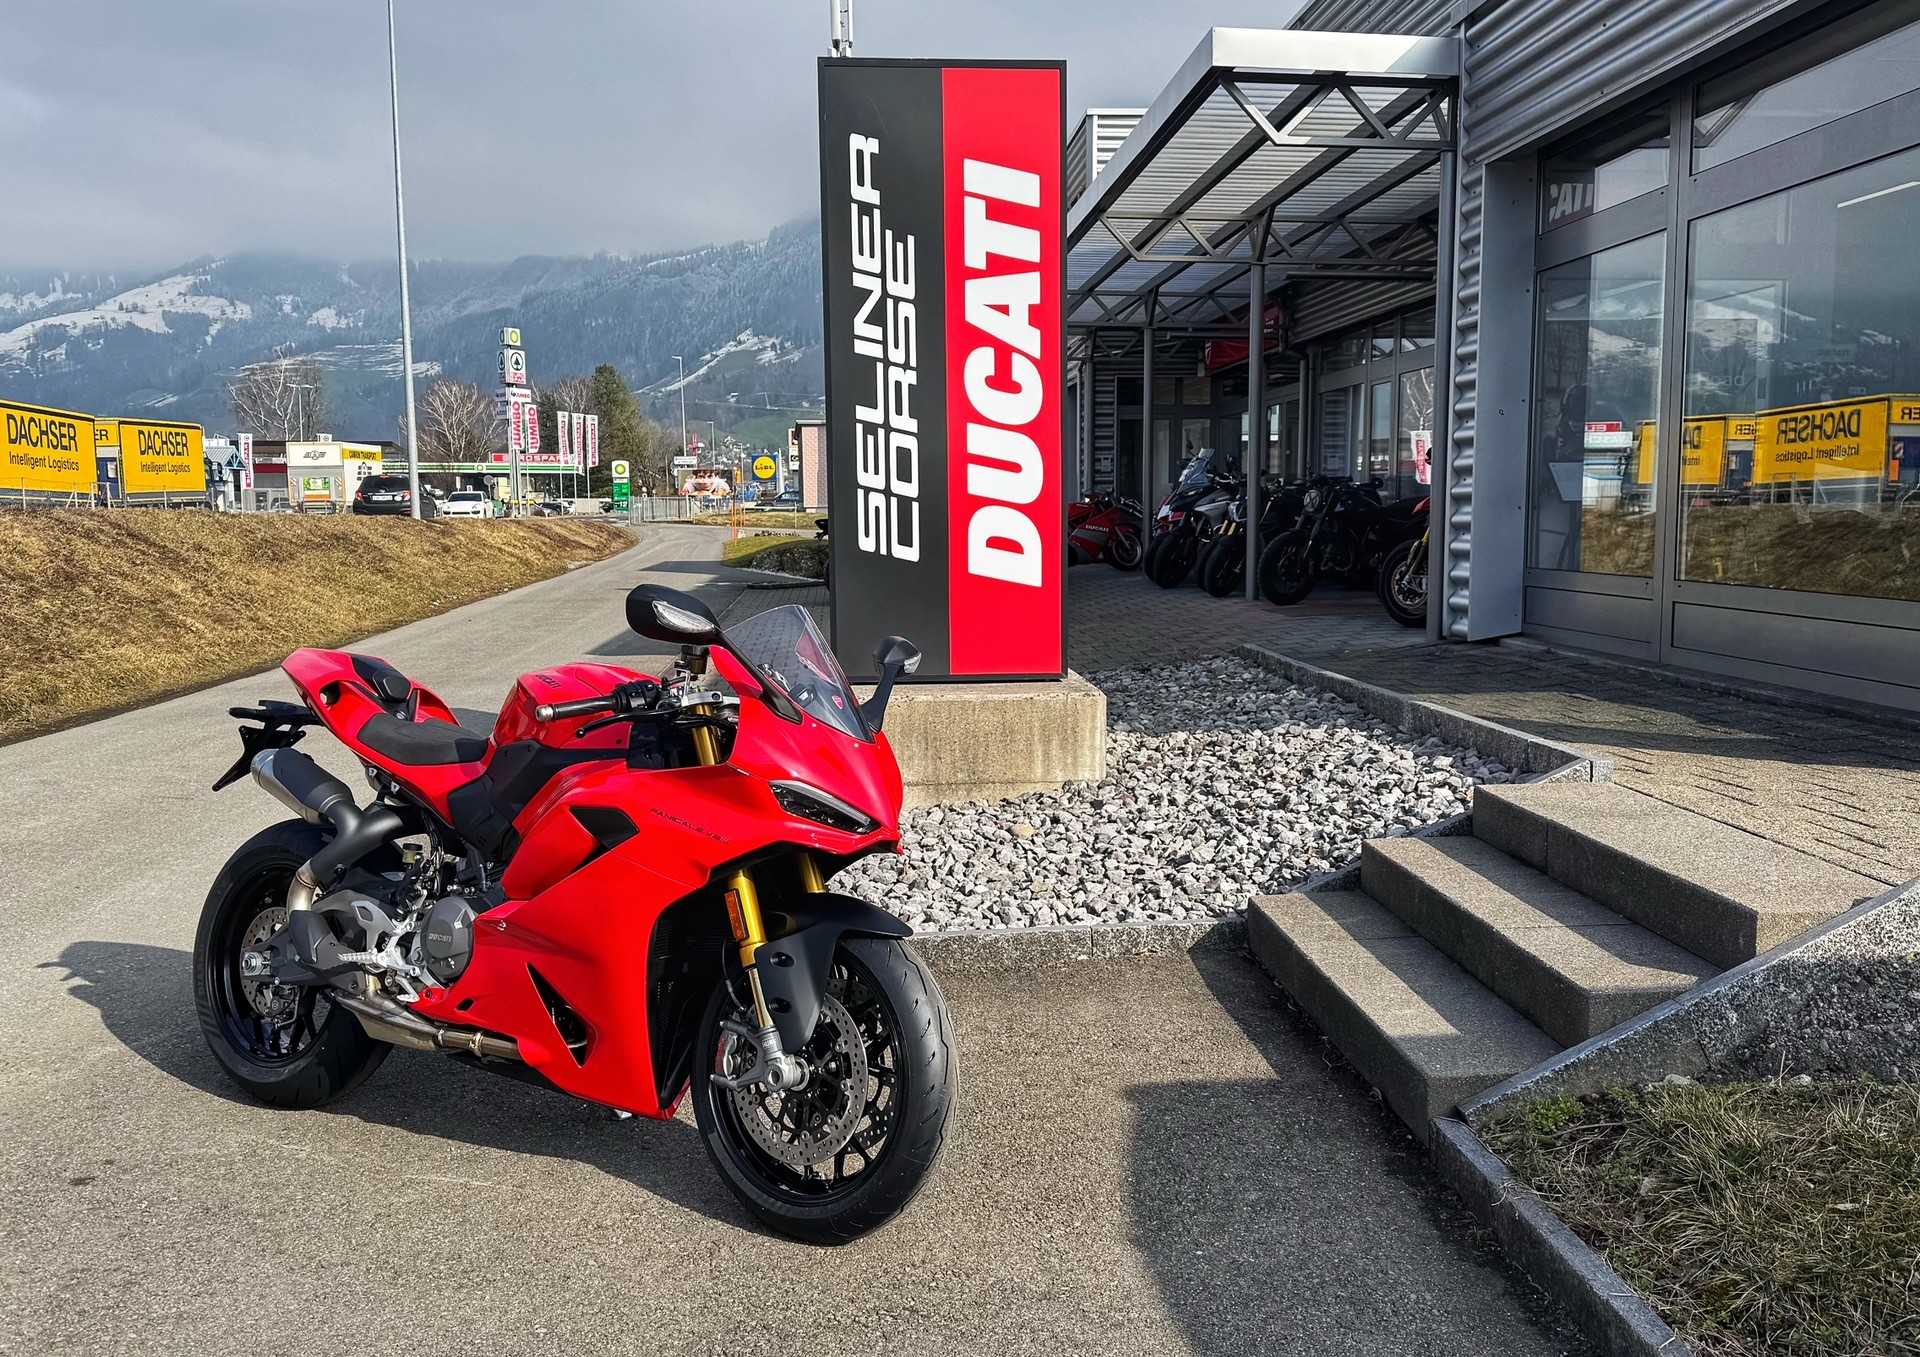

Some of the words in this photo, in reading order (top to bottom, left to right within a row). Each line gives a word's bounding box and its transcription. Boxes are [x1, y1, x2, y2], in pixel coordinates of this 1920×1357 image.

[848, 132, 887, 556] SELINER
[963, 158, 1044, 588] DUCATI
[884, 229, 920, 562] CORSE
[6, 413, 79, 452] DACHSER
[511, 401, 522, 448] JUMBO
[138, 429, 190, 457] DACHSER
[9, 451, 47, 471] Intelligent
[48, 458, 80, 473] Logistics
[140, 461, 167, 475] Intelligent
[168, 461, 191, 475] Logistics
[1085, 524, 1109, 532] DUCATI
[428, 933, 452, 943] DUCATI
